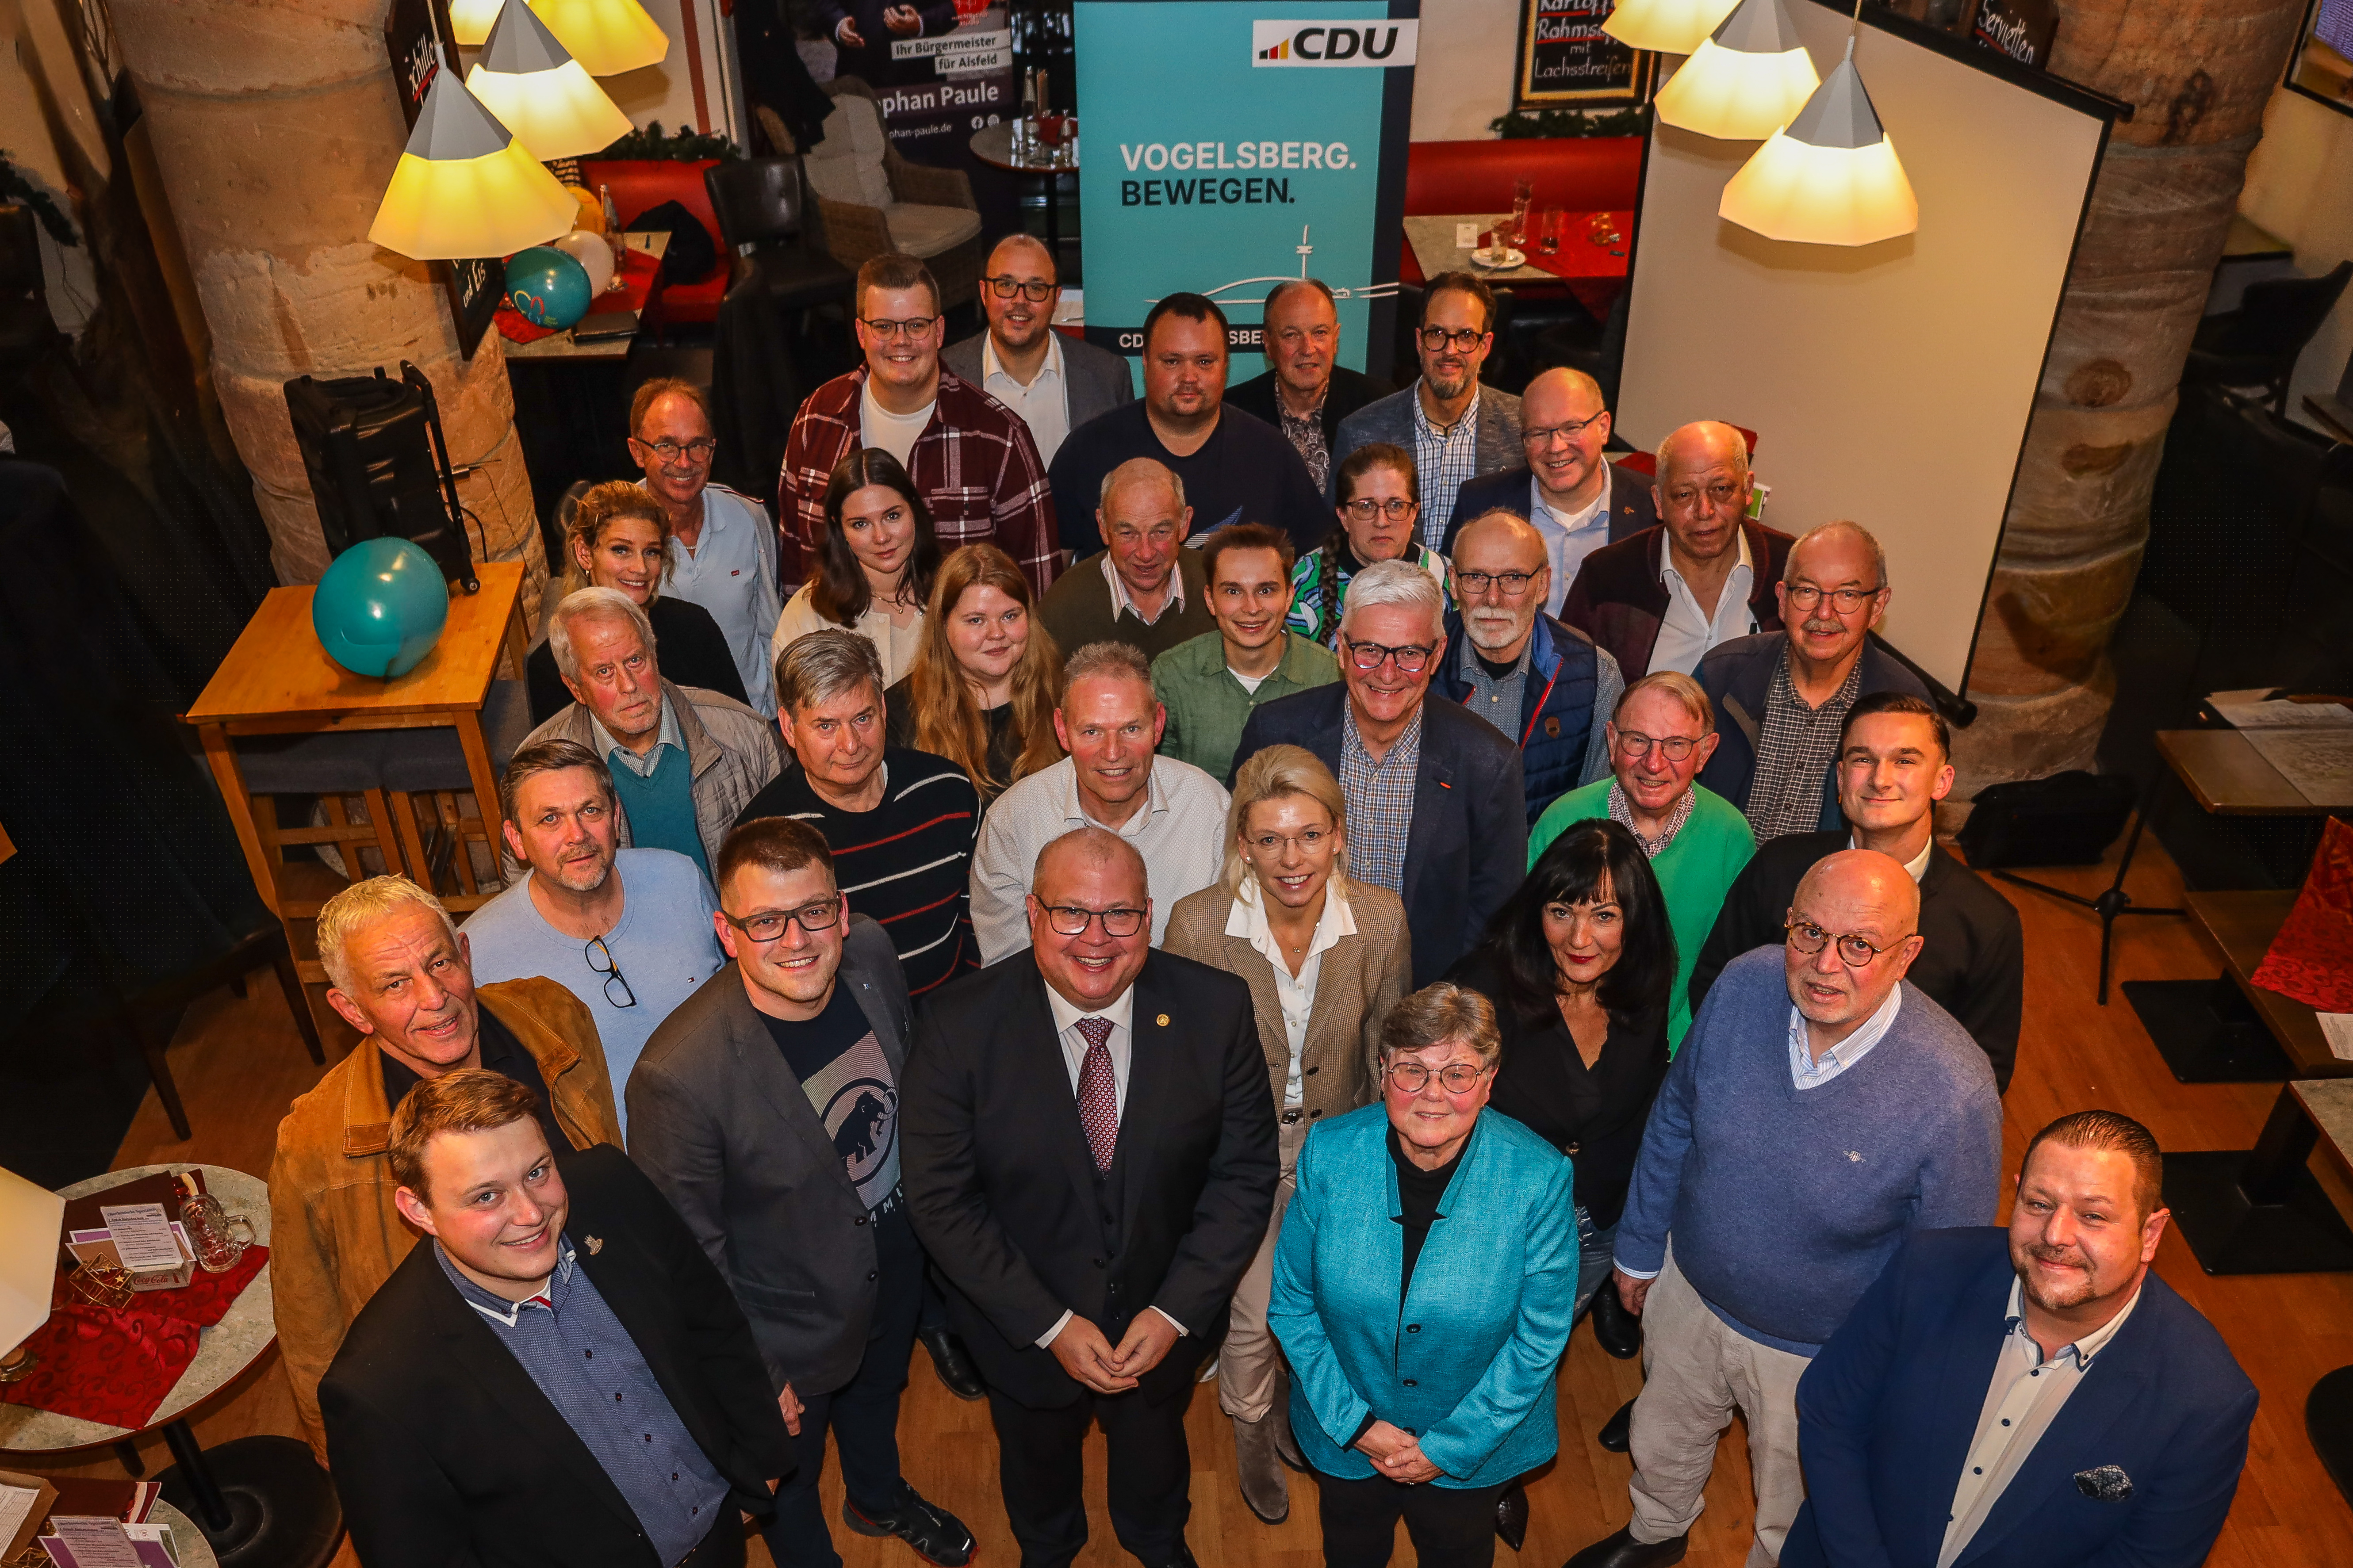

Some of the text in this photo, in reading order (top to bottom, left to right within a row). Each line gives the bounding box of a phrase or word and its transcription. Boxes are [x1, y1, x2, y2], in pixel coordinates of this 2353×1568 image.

[896, 36, 996, 55] Ihr Bürgermeister
[1293, 27, 1399, 60] CDU
[1570, 41, 1591, 54] mit
[939, 53, 997, 69] für Alsfeld
[1534, 55, 1632, 83] Lachsstreifen
[878, 81, 998, 119] phan Paule
[1119, 141, 1357, 172] VOGELSBERG.
[1121, 177, 1295, 207] BEWEGEN.
[1119, 333, 1144, 348] CD
